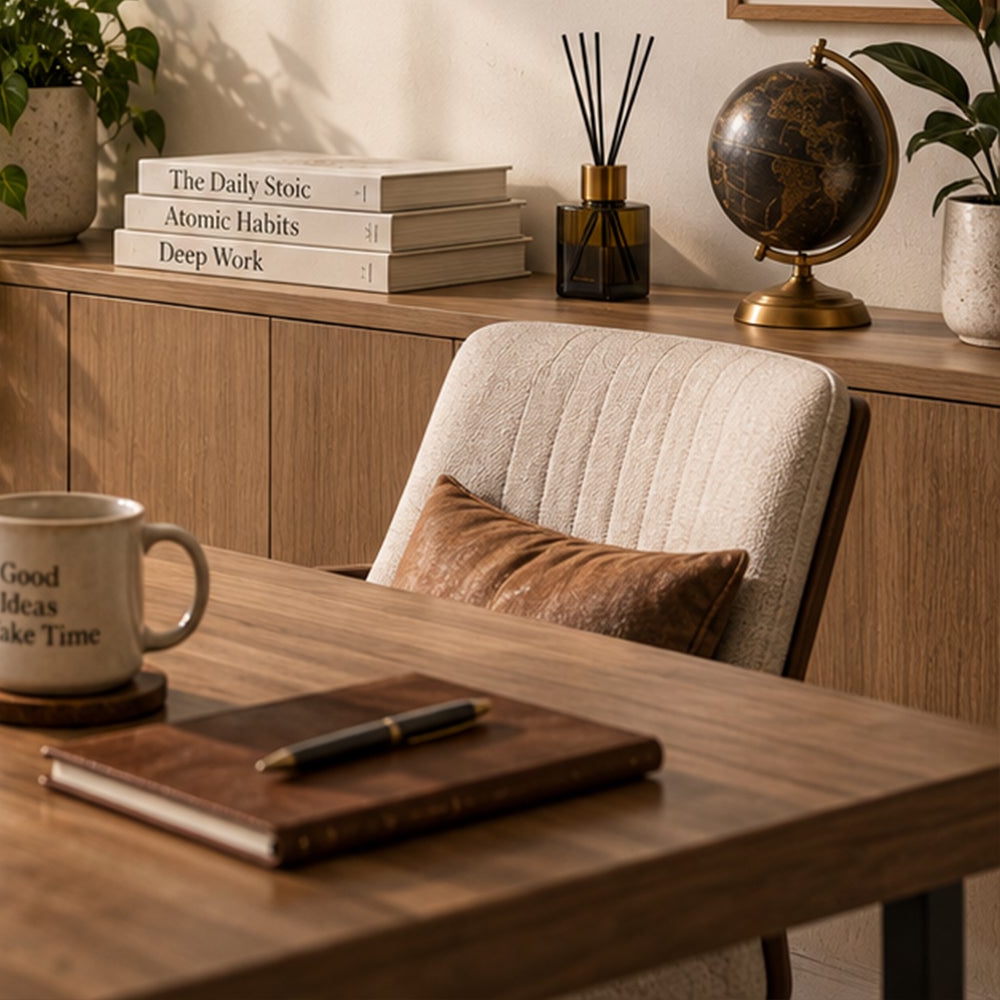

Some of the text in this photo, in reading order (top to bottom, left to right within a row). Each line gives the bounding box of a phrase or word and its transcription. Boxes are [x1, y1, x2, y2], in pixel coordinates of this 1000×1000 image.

[168, 168, 311, 201] The Daily Stoic
[163, 205, 300, 237] Atomic Habits
[159, 241, 264, 272] Deep Work
[0, 561, 61, 589] Good
[0, 591, 59, 617] Ideas
[41, 623, 102, 648] Time
